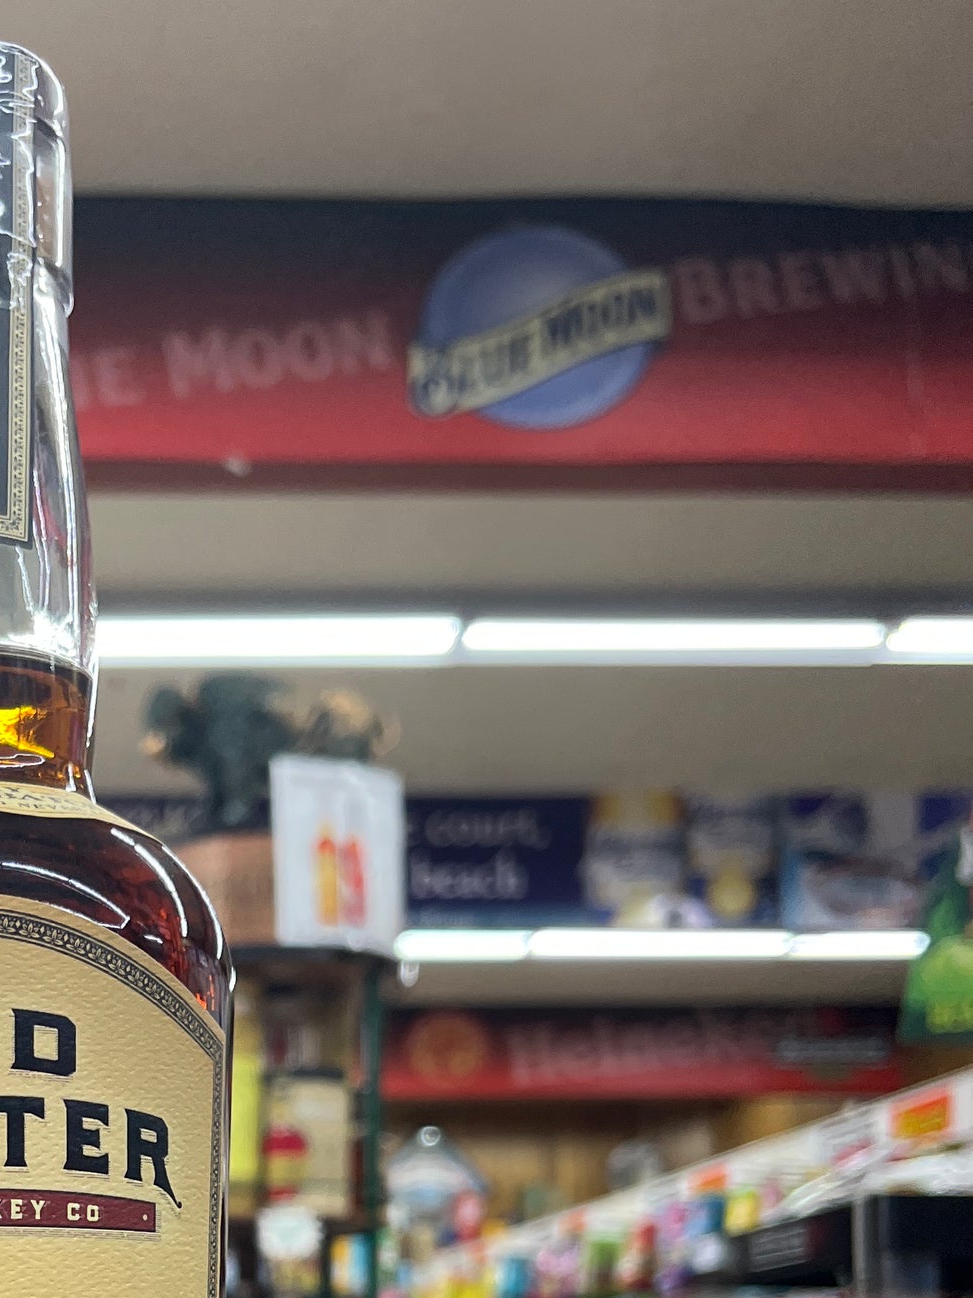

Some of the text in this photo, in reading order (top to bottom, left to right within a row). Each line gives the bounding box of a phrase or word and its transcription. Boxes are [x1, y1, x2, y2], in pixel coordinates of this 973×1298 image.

[161, 309, 393, 399] MOON
[539, 284, 659, 356] MOON
[66, 1202, 101, 1223] CO
